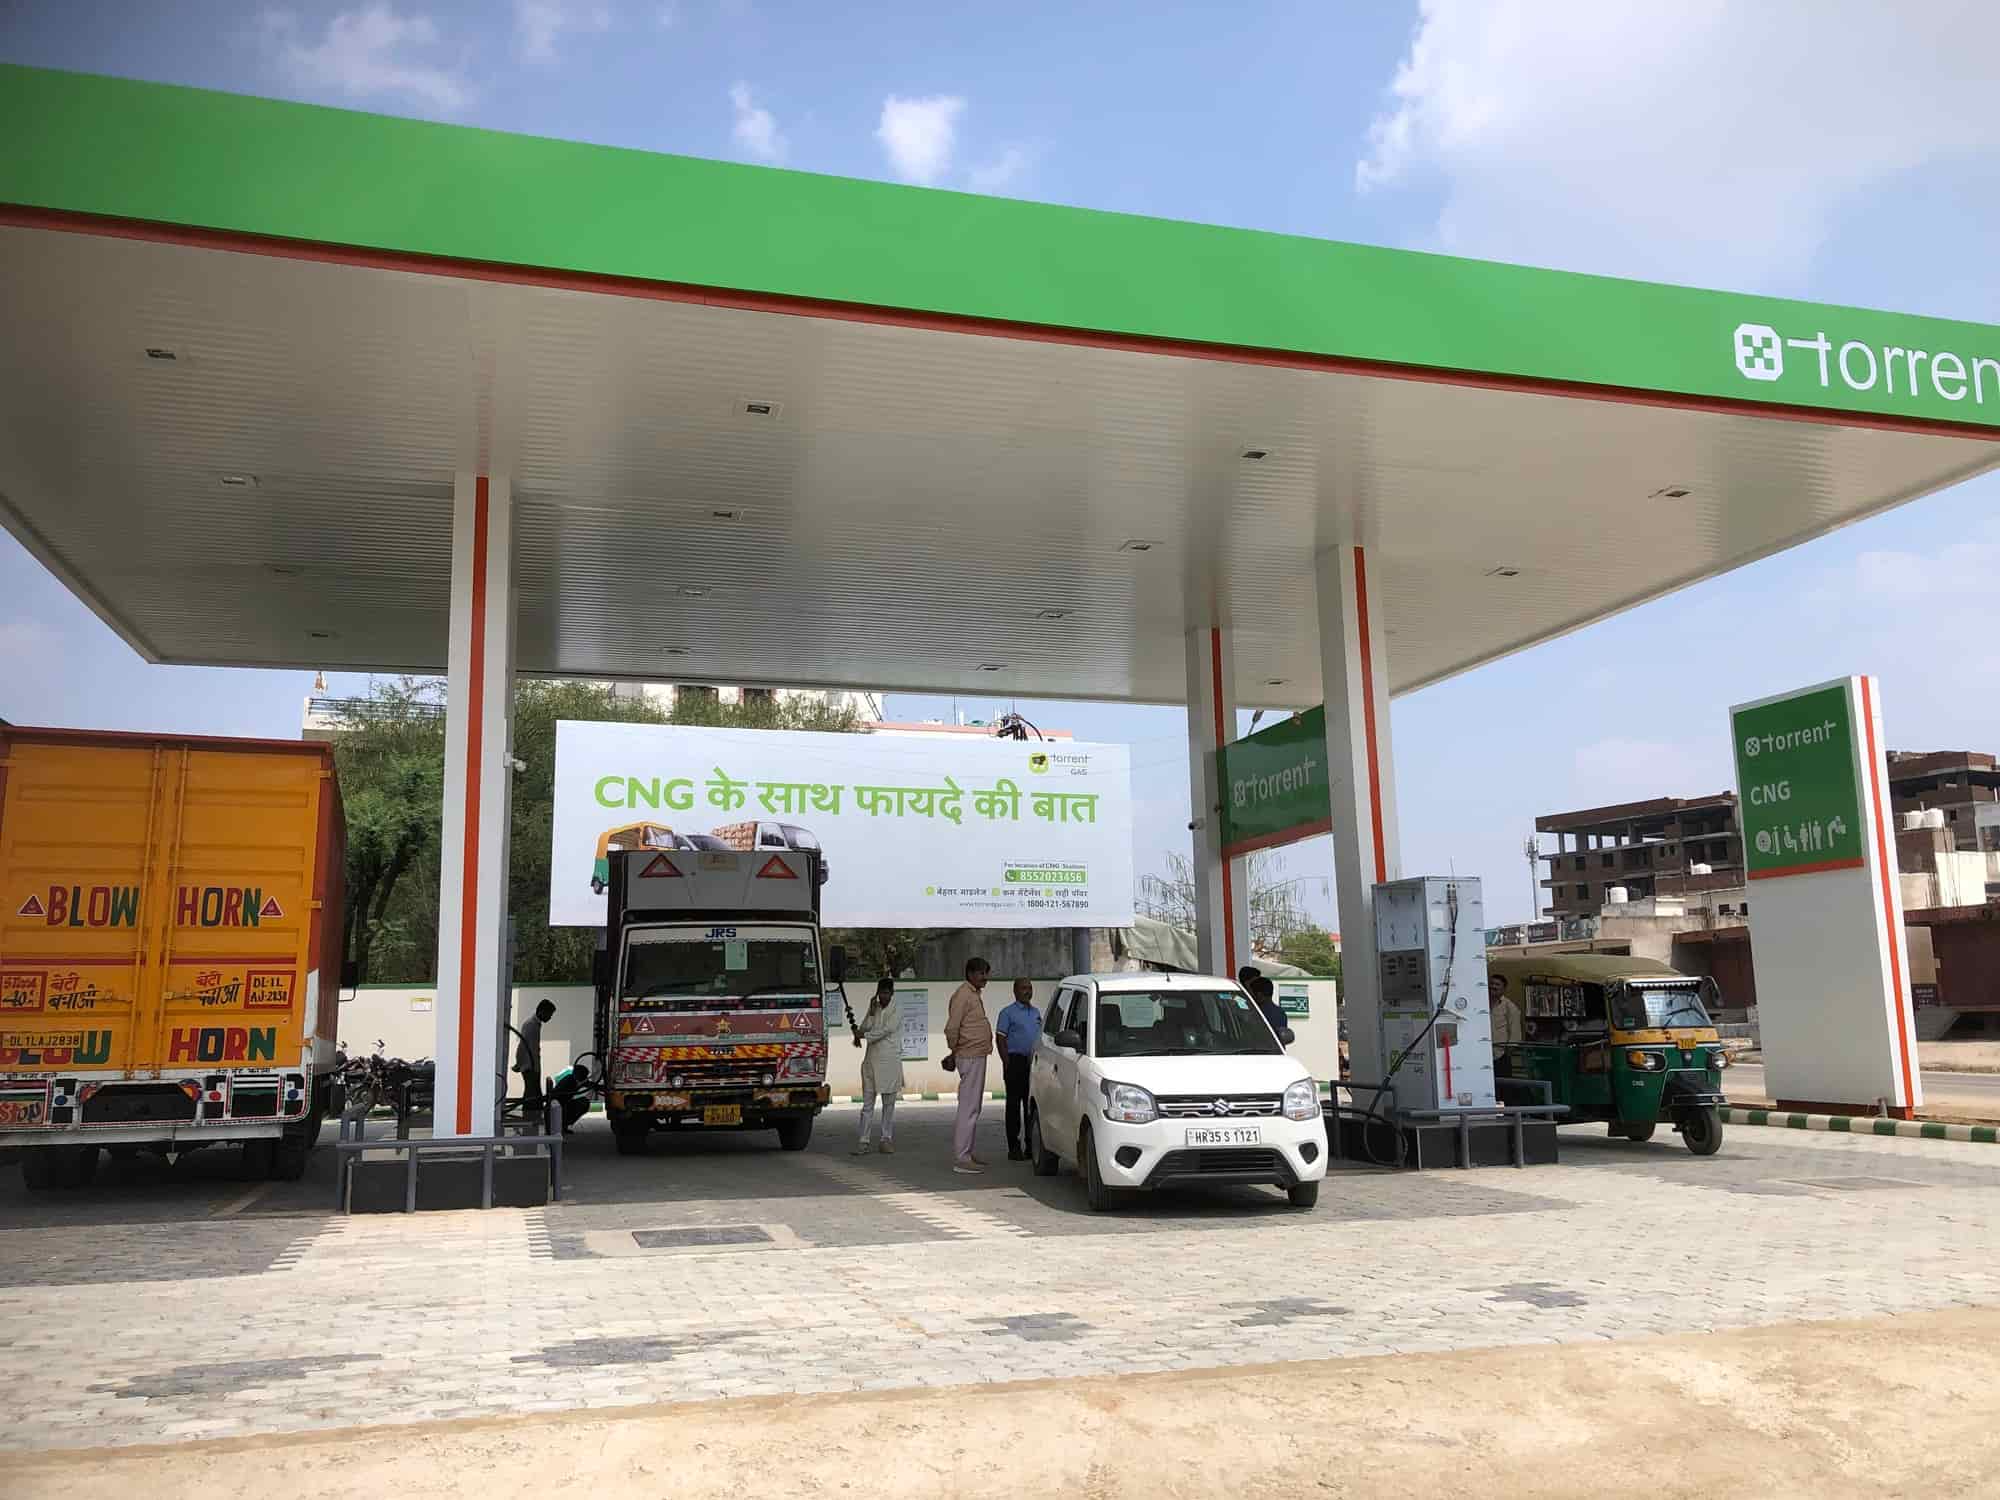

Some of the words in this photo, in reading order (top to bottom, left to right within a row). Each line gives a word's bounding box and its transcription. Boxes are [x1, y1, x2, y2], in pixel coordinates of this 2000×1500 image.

[1762, 719, 1837, 752] torrent
[1070, 768, 1088, 776] GAS
[1246, 754, 1317, 806] torrent
[594, 776, 694, 811] CNG
[705, 768, 748, 812] के
[756, 780, 844, 816] साथ
[854, 776, 965, 824] फायदे
[972, 778, 1023, 820] की
[1031, 792, 1099, 823] बात
[1751, 781, 1791, 805] CNG
[47, 886, 139, 927] BLOW
[177, 887, 262, 927] HORN
[705, 928, 737, 938] JRS
[168, 1028, 275, 1062] HORN
[1195, 1130, 1222, 1143] HR35
[1223, 1131, 1231, 1143] S
[1233, 1130, 1259, 1143] 1121
